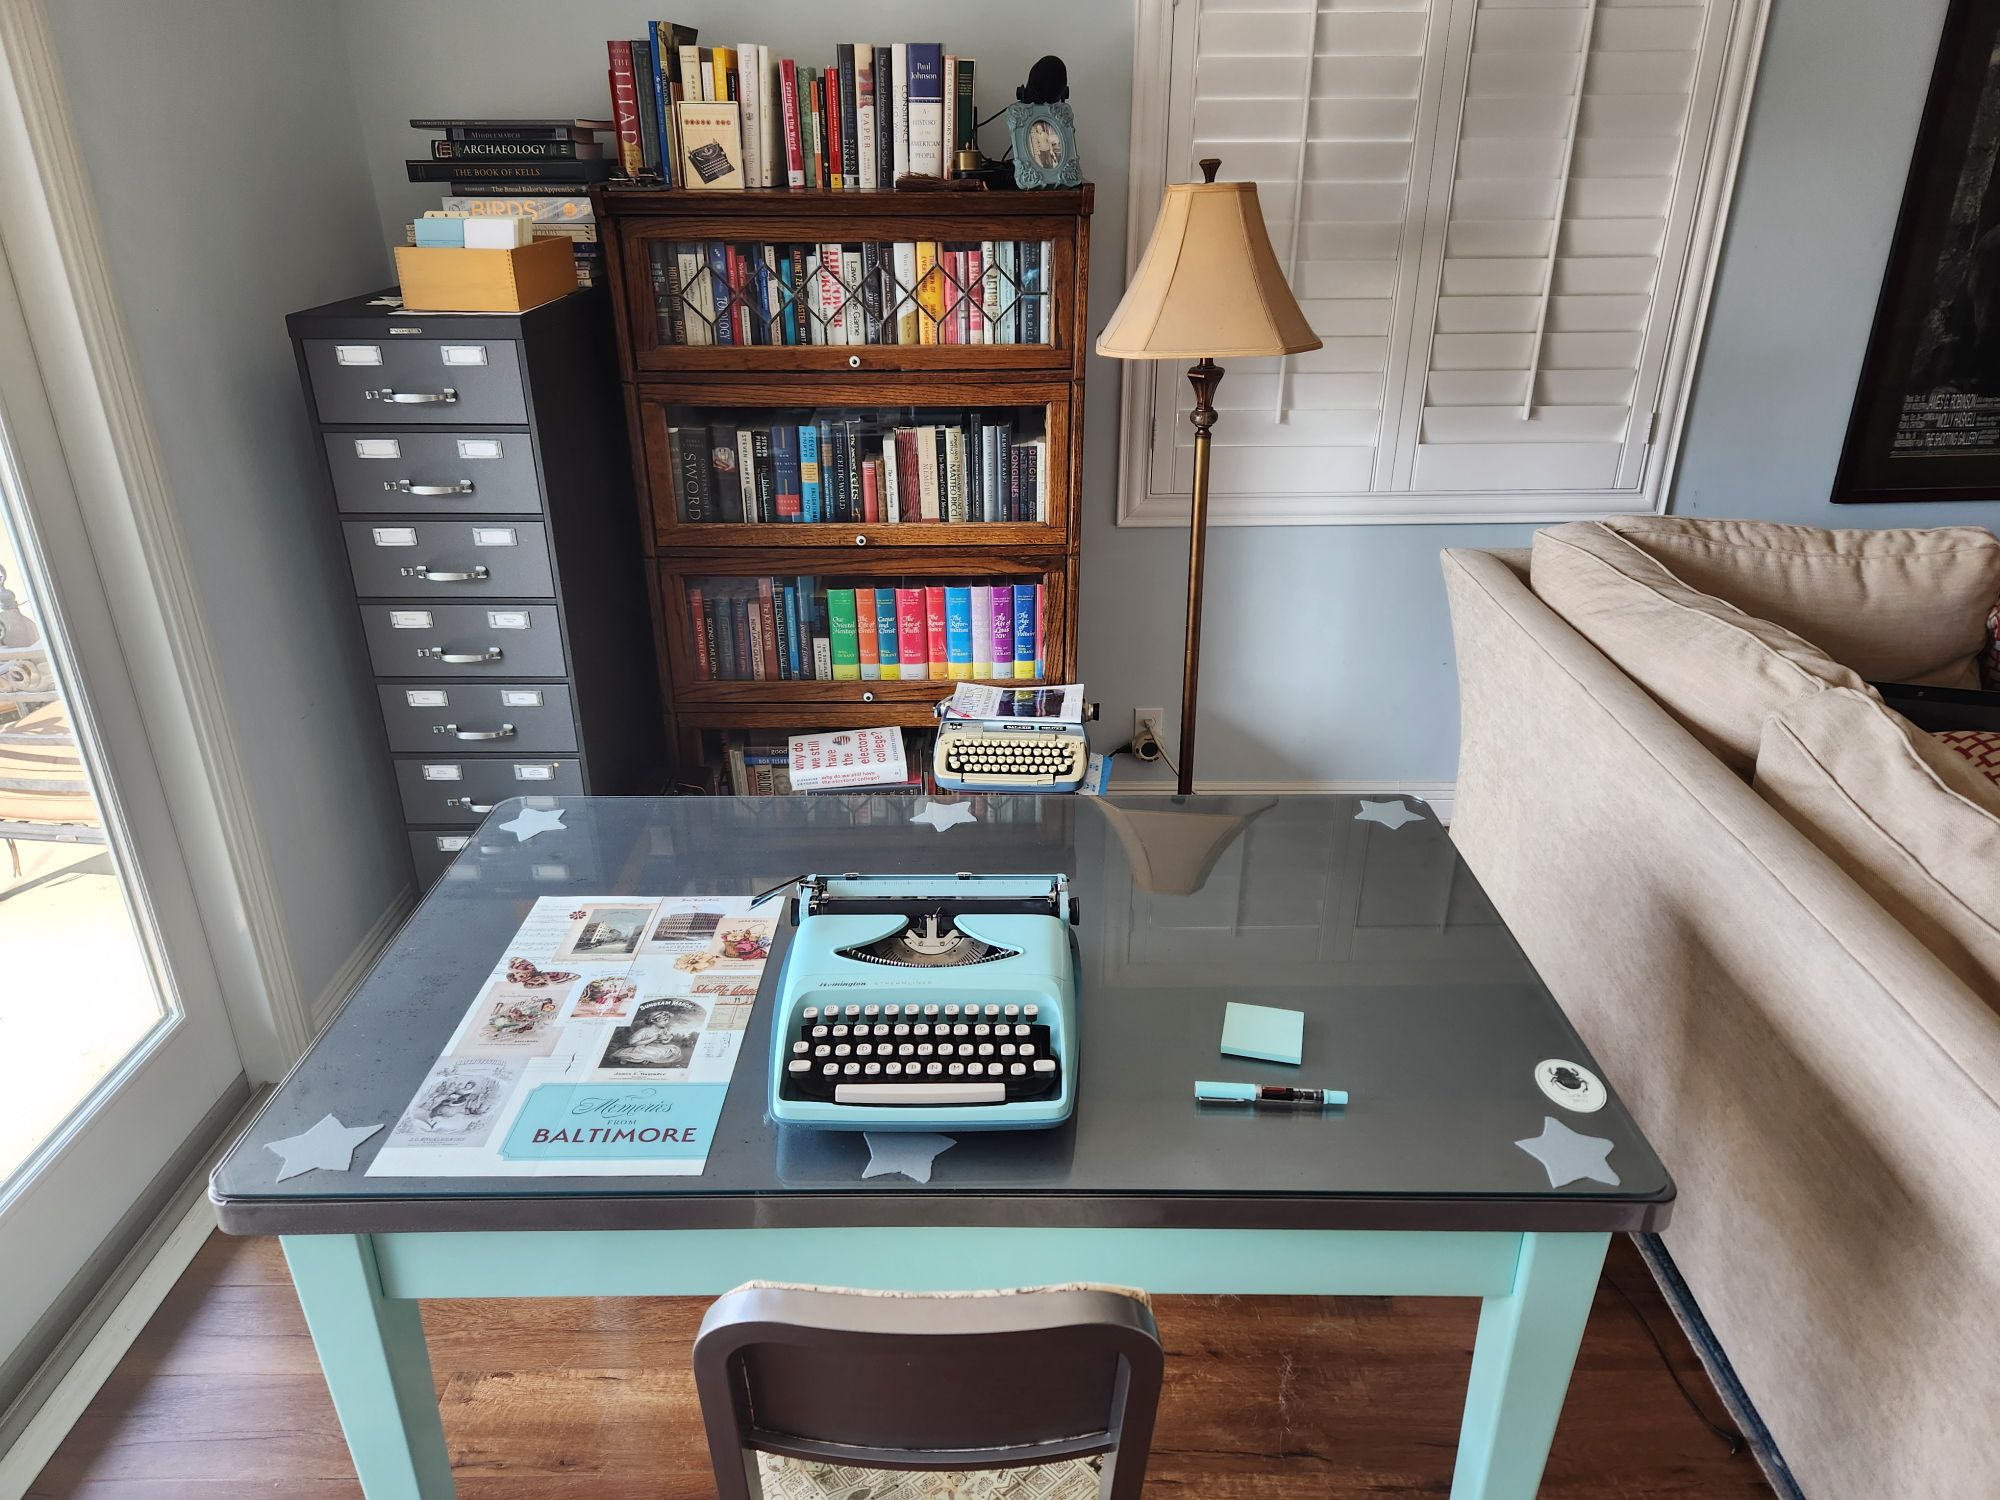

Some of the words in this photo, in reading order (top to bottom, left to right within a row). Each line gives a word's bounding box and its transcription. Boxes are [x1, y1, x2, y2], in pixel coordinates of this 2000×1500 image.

[879, 54, 887, 67] The
[916, 62, 931, 71] Paul
[880, 68, 888, 88] Ascent
[910, 71, 938, 80] Johnson
[744, 71, 753, 109] Notebook
[614, 70, 638, 146] ILIAD
[784, 81, 795, 118] Cataloging
[790, 131, 799, 151] World
[863, 113, 872, 149] PAPER
[463, 144, 546, 154] ARCHAEOLOGY
[454, 168, 472, 177] THE
[474, 168, 499, 177] BOOK
[500, 168, 513, 176] OF
[515, 168, 541, 176] KELLS
[491, 185, 502, 193] The
[503, 185, 521, 193] Bread
[521, 185, 544, 193] Baker's
[544, 185, 576, 194] Apprentice
[470, 200, 538, 222] BIRDS
[794, 250, 803, 276] ANTINET
[850, 261, 858, 284] Laws
[986, 274, 998, 307] ACTION
[853, 311, 861, 336] Game
[1950, 393, 1978, 410] ROBINSON
[1936, 412, 1953, 428] MOLLY
[1953, 412, 1977, 427] HASKELL
[741, 434, 749, 458] STEVEN
[755, 435, 763, 458] PINKER
[761, 435, 769, 458] STEVEN
[807, 431, 816, 458] STEVEN
[1935, 432, 1958, 446] SHOOTING
[1957, 431, 1980, 446] GALLERY
[743, 460, 751, 485] PINKER
[836, 454, 845, 482] CELTIC
[1011, 449, 1019, 498] SONGLINES
[1028, 449, 1037, 482] DESIGN
[683, 452, 702, 521] SWORD
[761, 479, 771, 500] blank
[922, 463, 931, 498] MEMORY
[949, 463, 957, 496] MATTEO
[838, 482, 847, 510] WORLD
[950, 496, 958, 518] RICCI
[763, 603, 771, 614] The
[773, 593, 783, 607] THE
[774, 607, 786, 635] ENGLISH
[1018, 611, 1029, 619] The
[705, 617, 714, 640] SECOND
[696, 634, 705, 648] YEAR
[708, 640, 716, 656] YEAR
[751, 633, 759, 648] LATIN
[698, 649, 706, 666] LATIN
[752, 649, 761, 677] GRAMMAR
[777, 636, 788, 668] LANGUAGE
[709, 657, 717, 673] LATIN
[792, 742, 804, 752] do
[807, 740, 820, 756] still
[855, 730, 870, 765] electoral
[870, 731, 887, 763] college?
[792, 755, 806, 771] why
[811, 759, 821, 769] we
[825, 749, 838, 768] have
[841, 752, 853, 767] the
[756, 769, 772, 792] TABLOID
[692, 984, 730, 996] Shuffle
[818, 980, 867, 988] Remington
[571, 1096, 674, 1119] Memories
[531, 1127, 698, 1143] BALTIMORE
